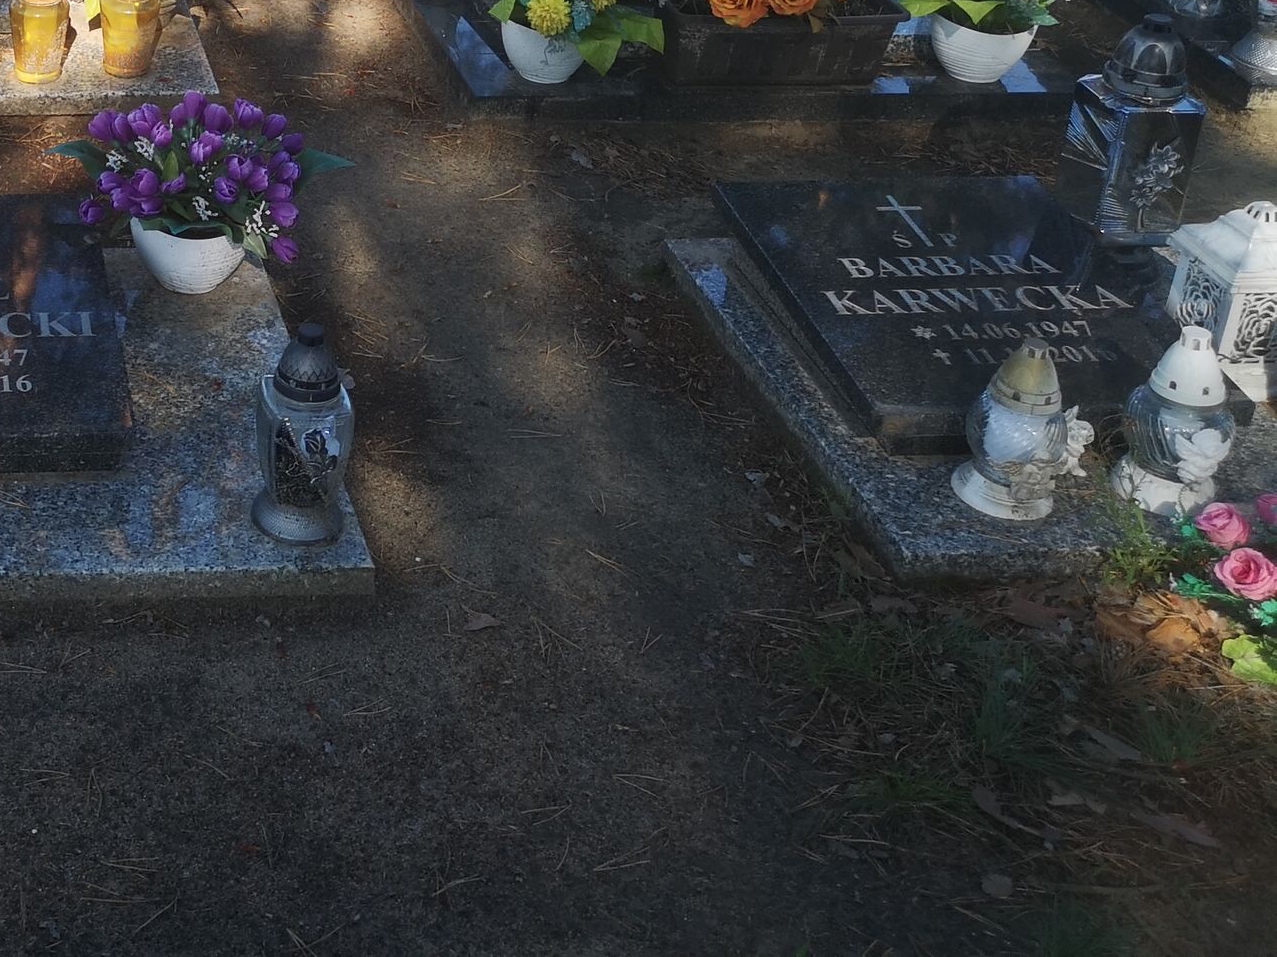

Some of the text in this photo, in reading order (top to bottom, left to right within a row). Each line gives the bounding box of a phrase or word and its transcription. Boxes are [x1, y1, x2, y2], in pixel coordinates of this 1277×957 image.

[837, 253, 1062, 279] BARBARA
[822, 284, 1134, 315] KARWECKA
[942, 320, 1092, 341] 14.06.1947
